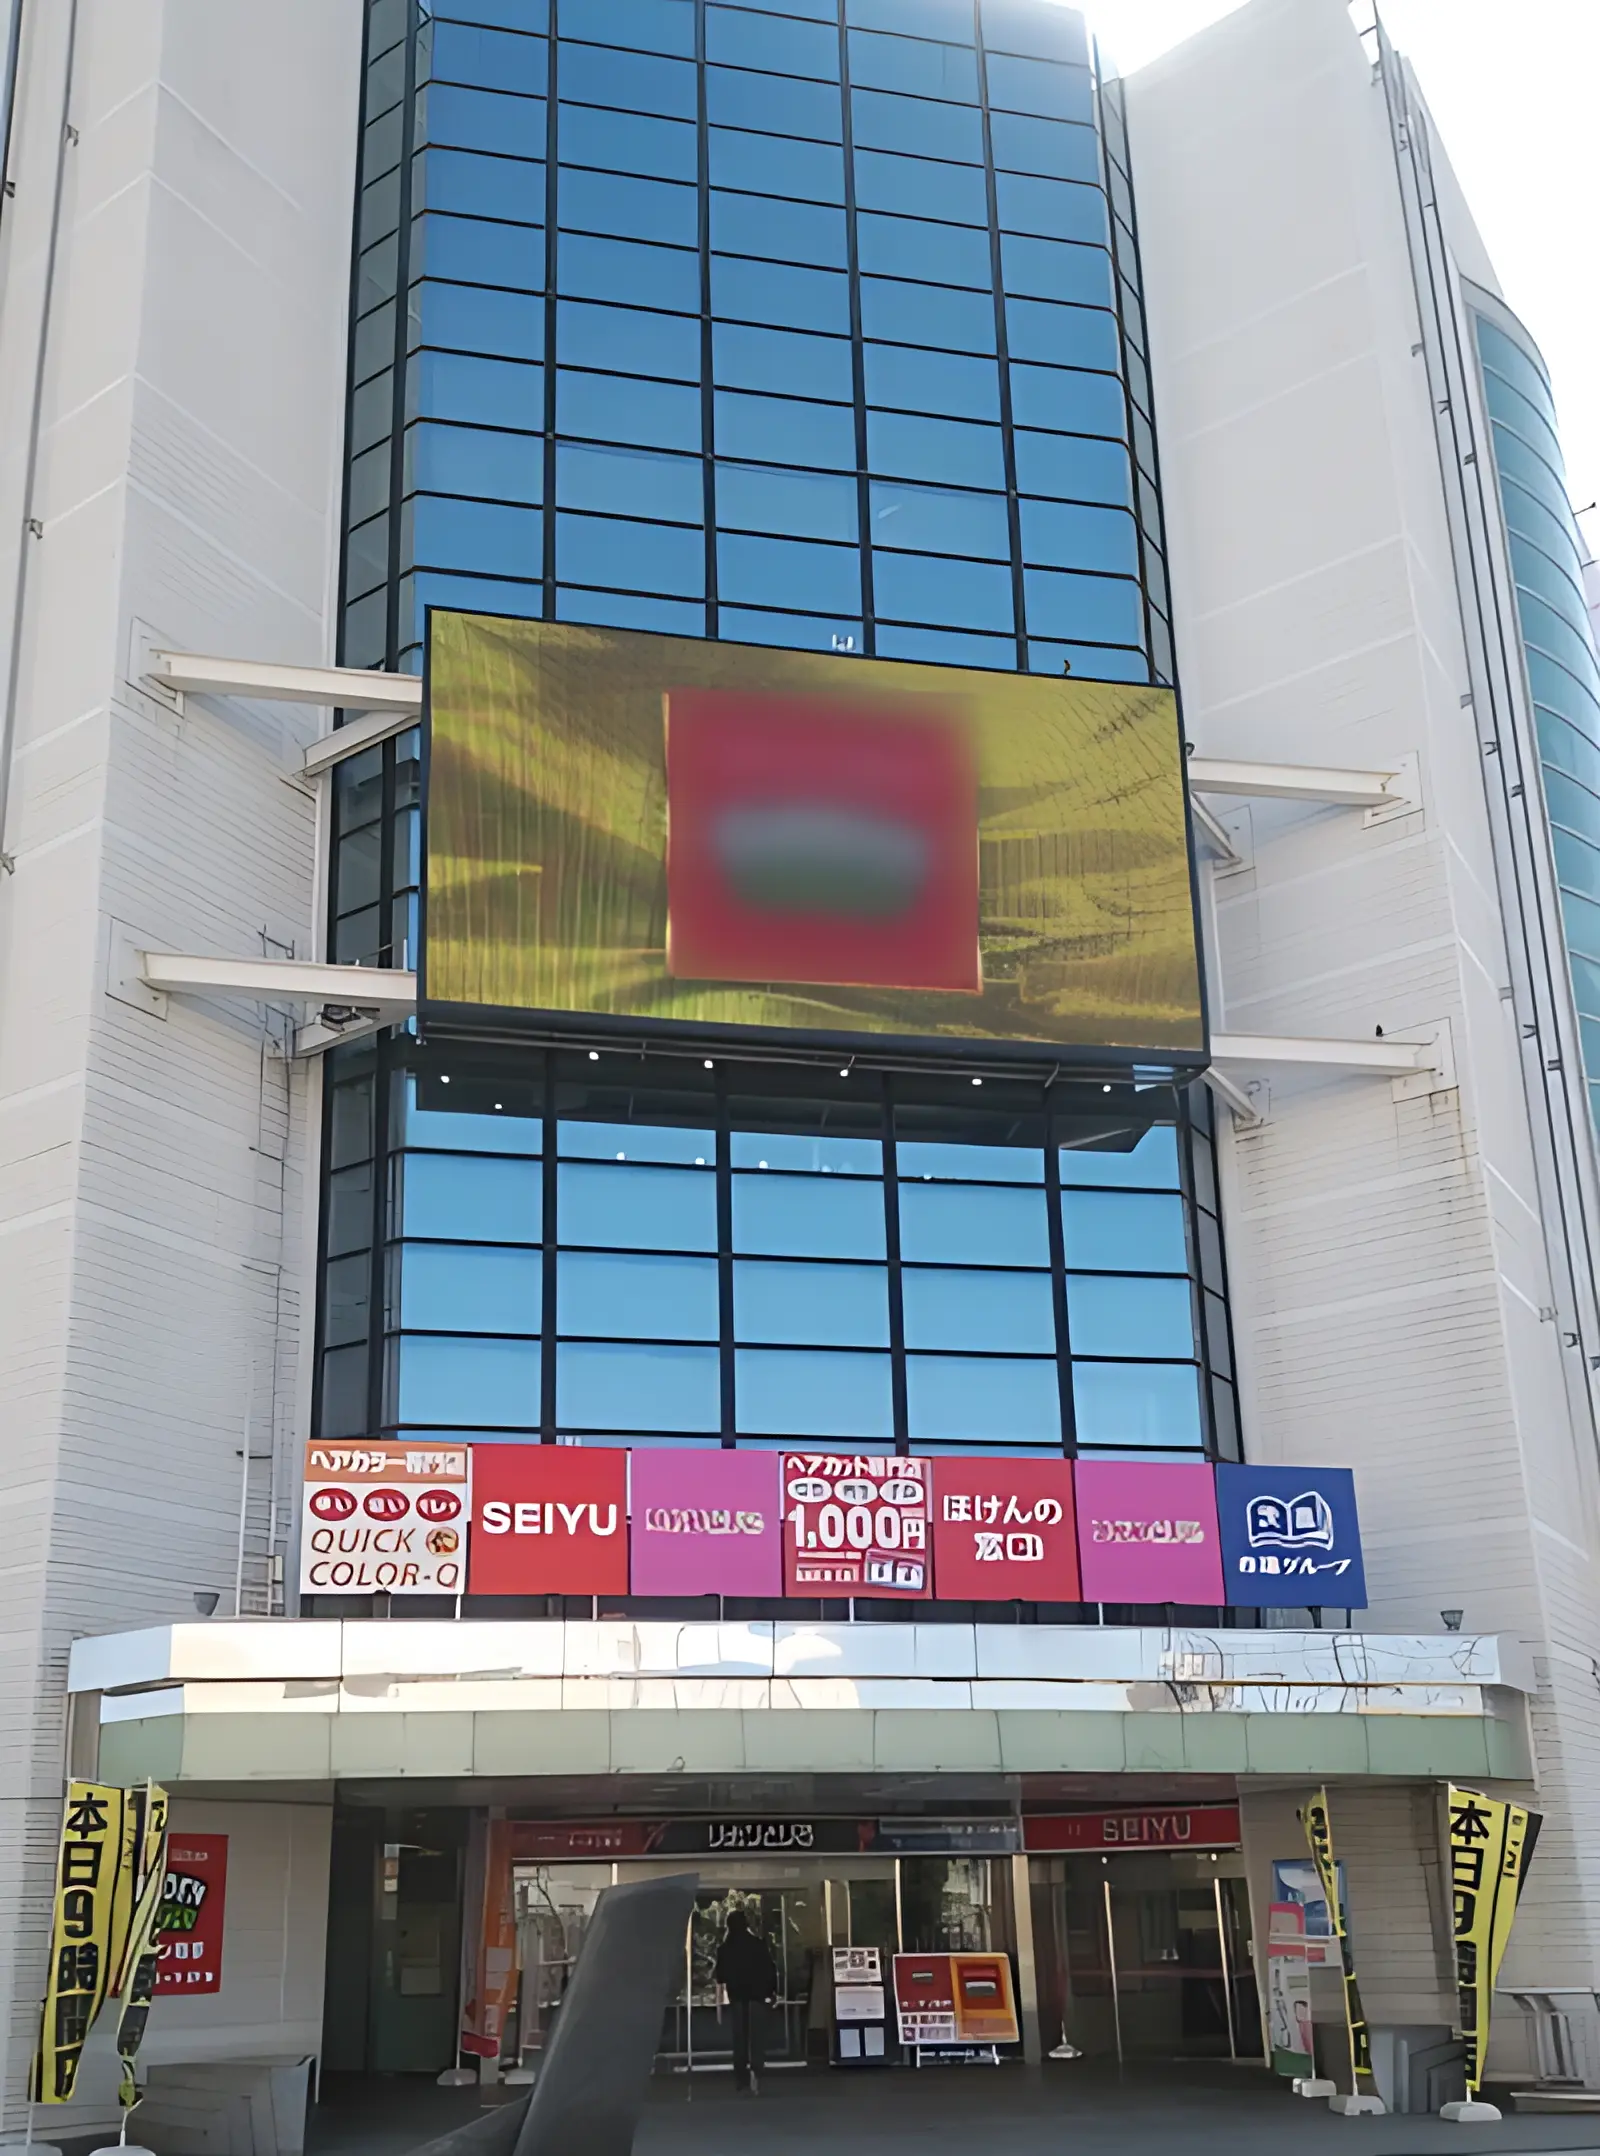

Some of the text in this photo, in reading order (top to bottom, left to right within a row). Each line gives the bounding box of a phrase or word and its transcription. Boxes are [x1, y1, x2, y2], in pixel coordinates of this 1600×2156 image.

[482, 1502, 618, 1537] SEIYU
[943, 1494, 1063, 1525] ほけんの
[310, 1527, 417, 1555] QUICK
[787, 1503, 926, 1550] 1,000円
[1103, 1814, 1192, 1842] SEIYU
